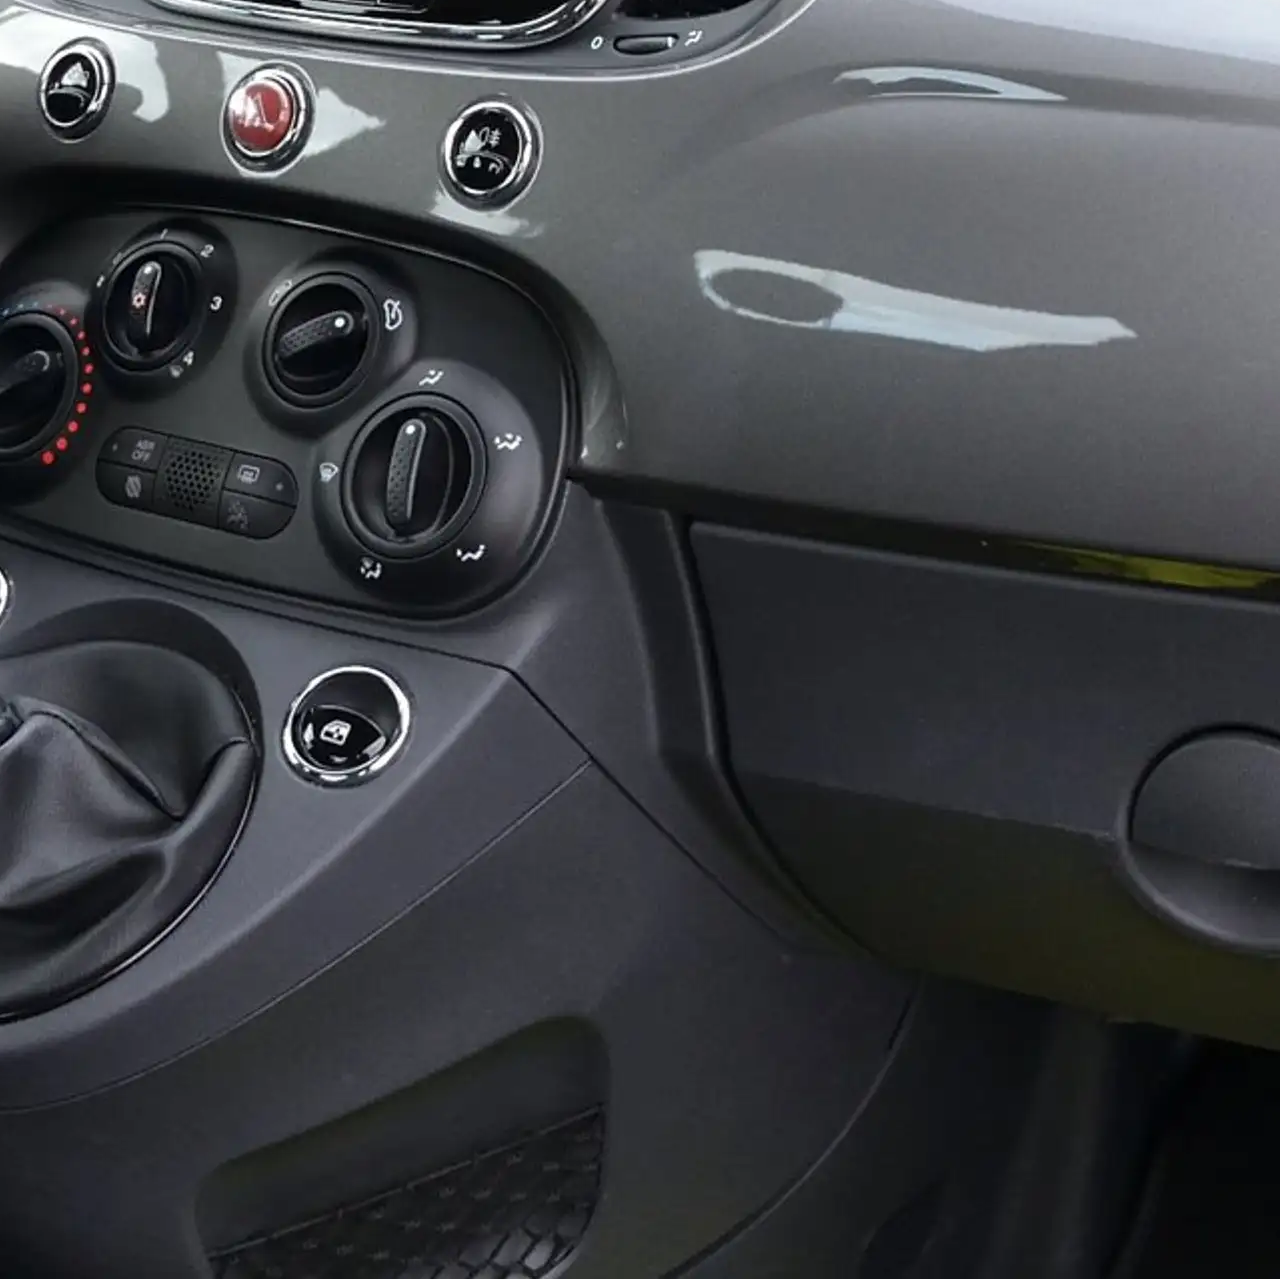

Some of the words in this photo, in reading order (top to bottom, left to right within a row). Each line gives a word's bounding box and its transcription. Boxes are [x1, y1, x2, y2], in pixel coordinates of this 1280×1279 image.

[200, 243, 215, 258] 2
[210, 295, 223, 311] 3
[183, 350, 195, 366] 4
